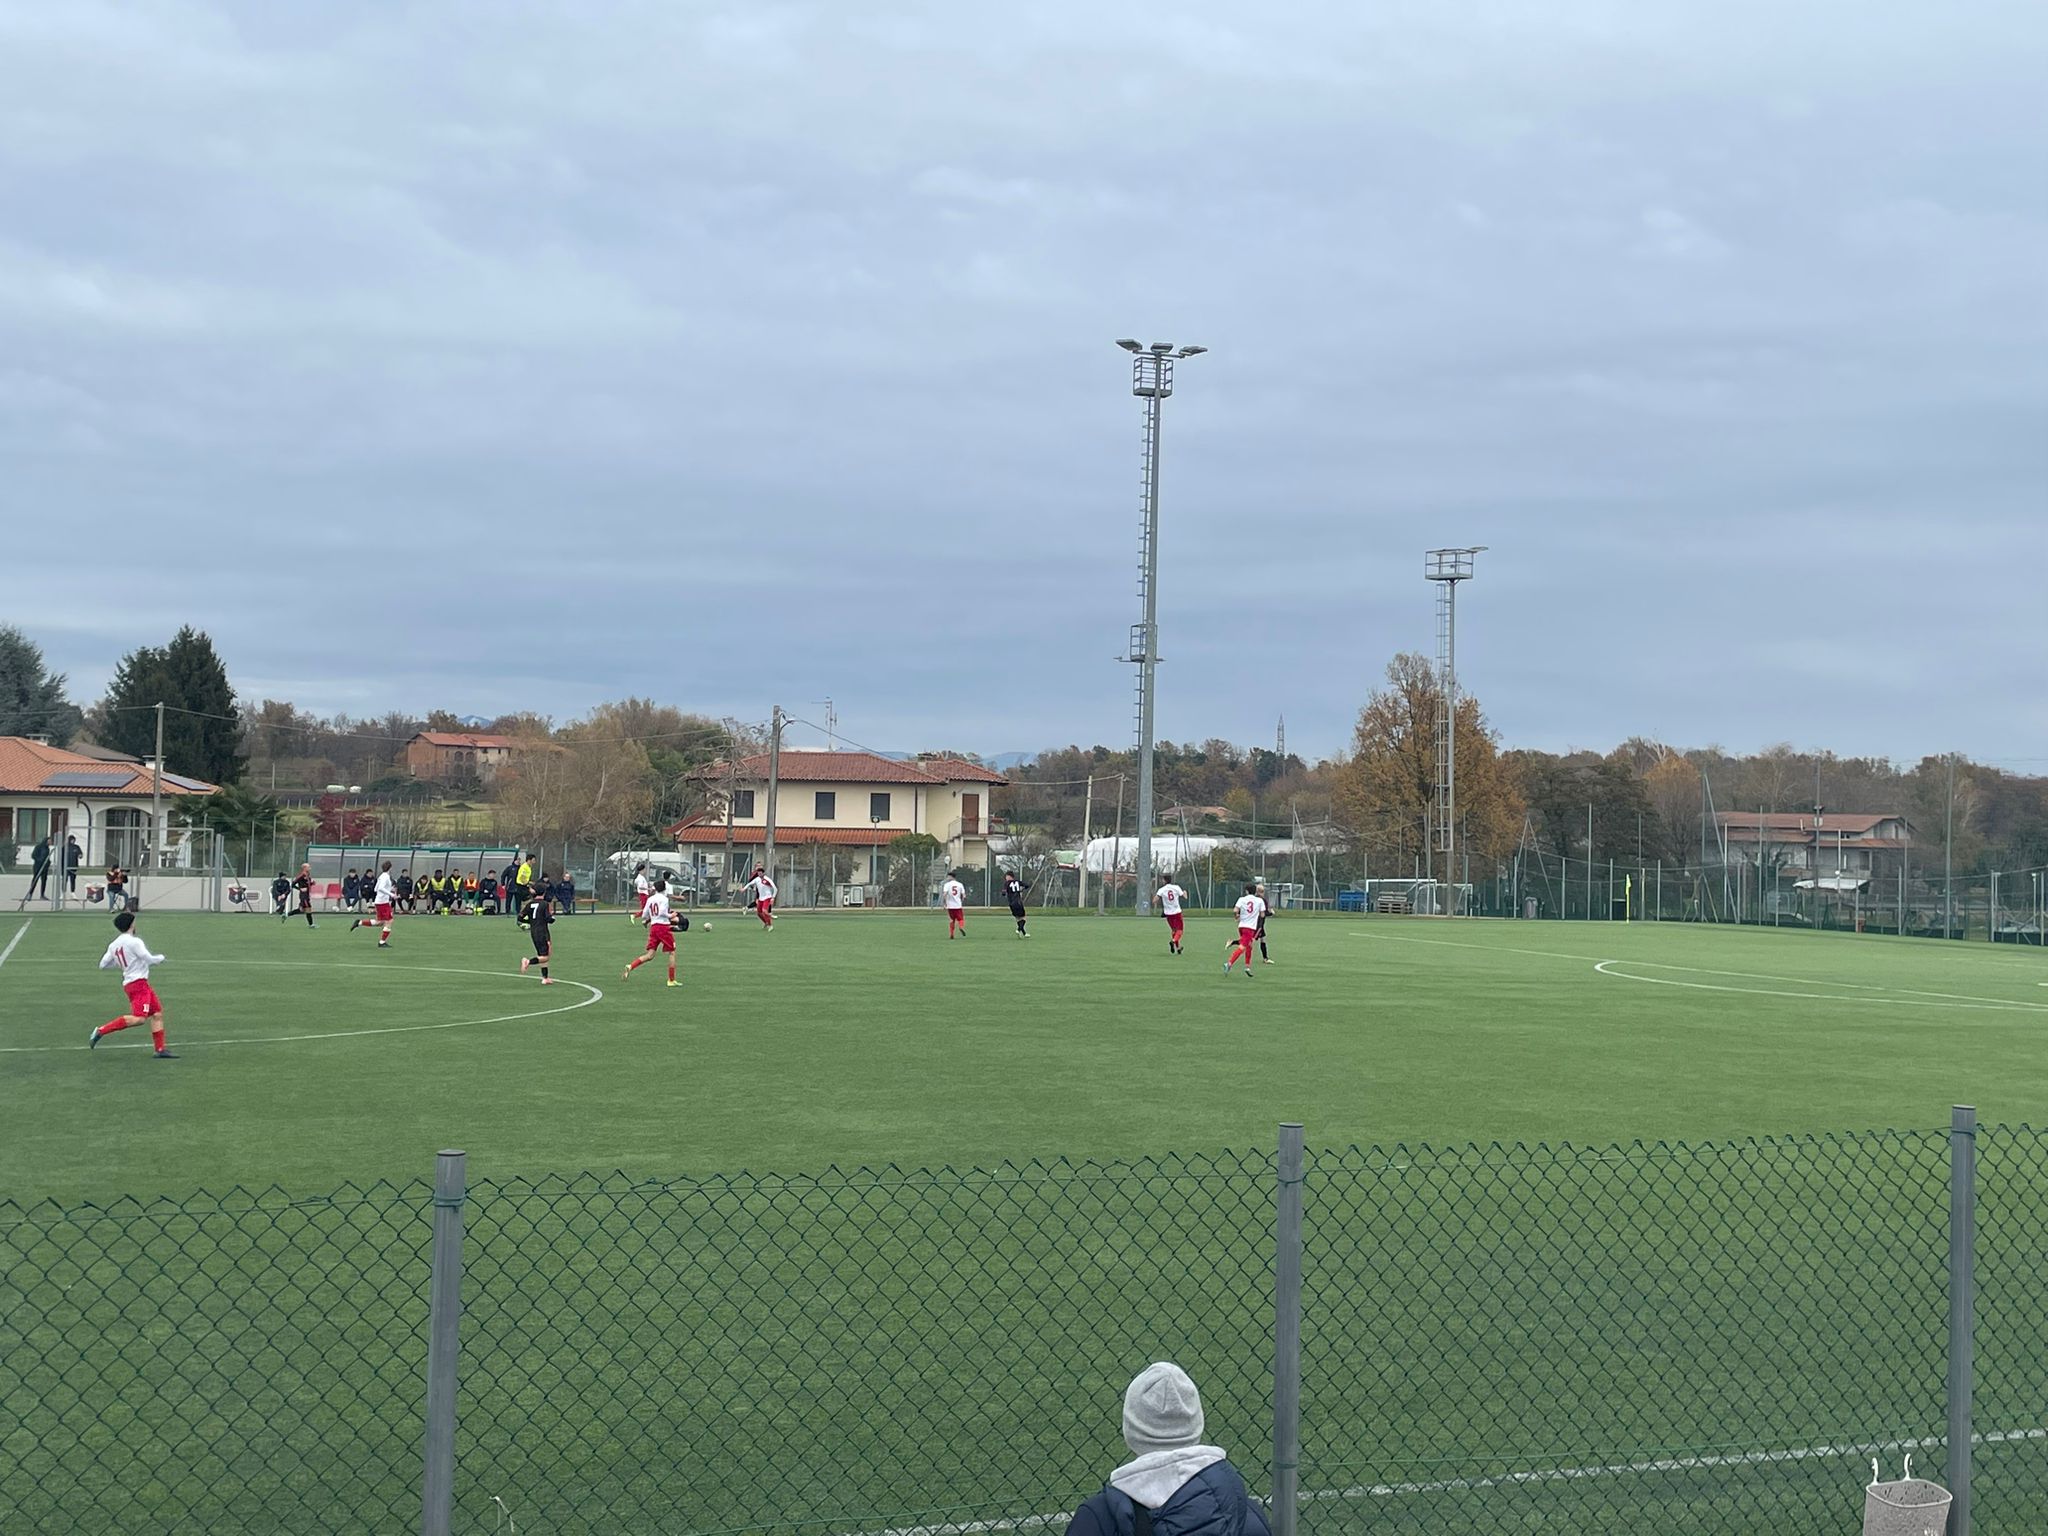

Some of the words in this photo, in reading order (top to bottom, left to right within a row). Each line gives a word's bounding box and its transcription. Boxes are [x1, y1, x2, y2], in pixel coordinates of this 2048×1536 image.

[952, 885, 958, 896] 5
[1009, 881, 1020, 892] 11
[1167, 890, 1174, 901] 6
[530, 903, 539, 919] 7
[649, 903, 659, 917] 10
[1246, 901, 1254, 913] 3
[114, 946, 128, 968] 11
